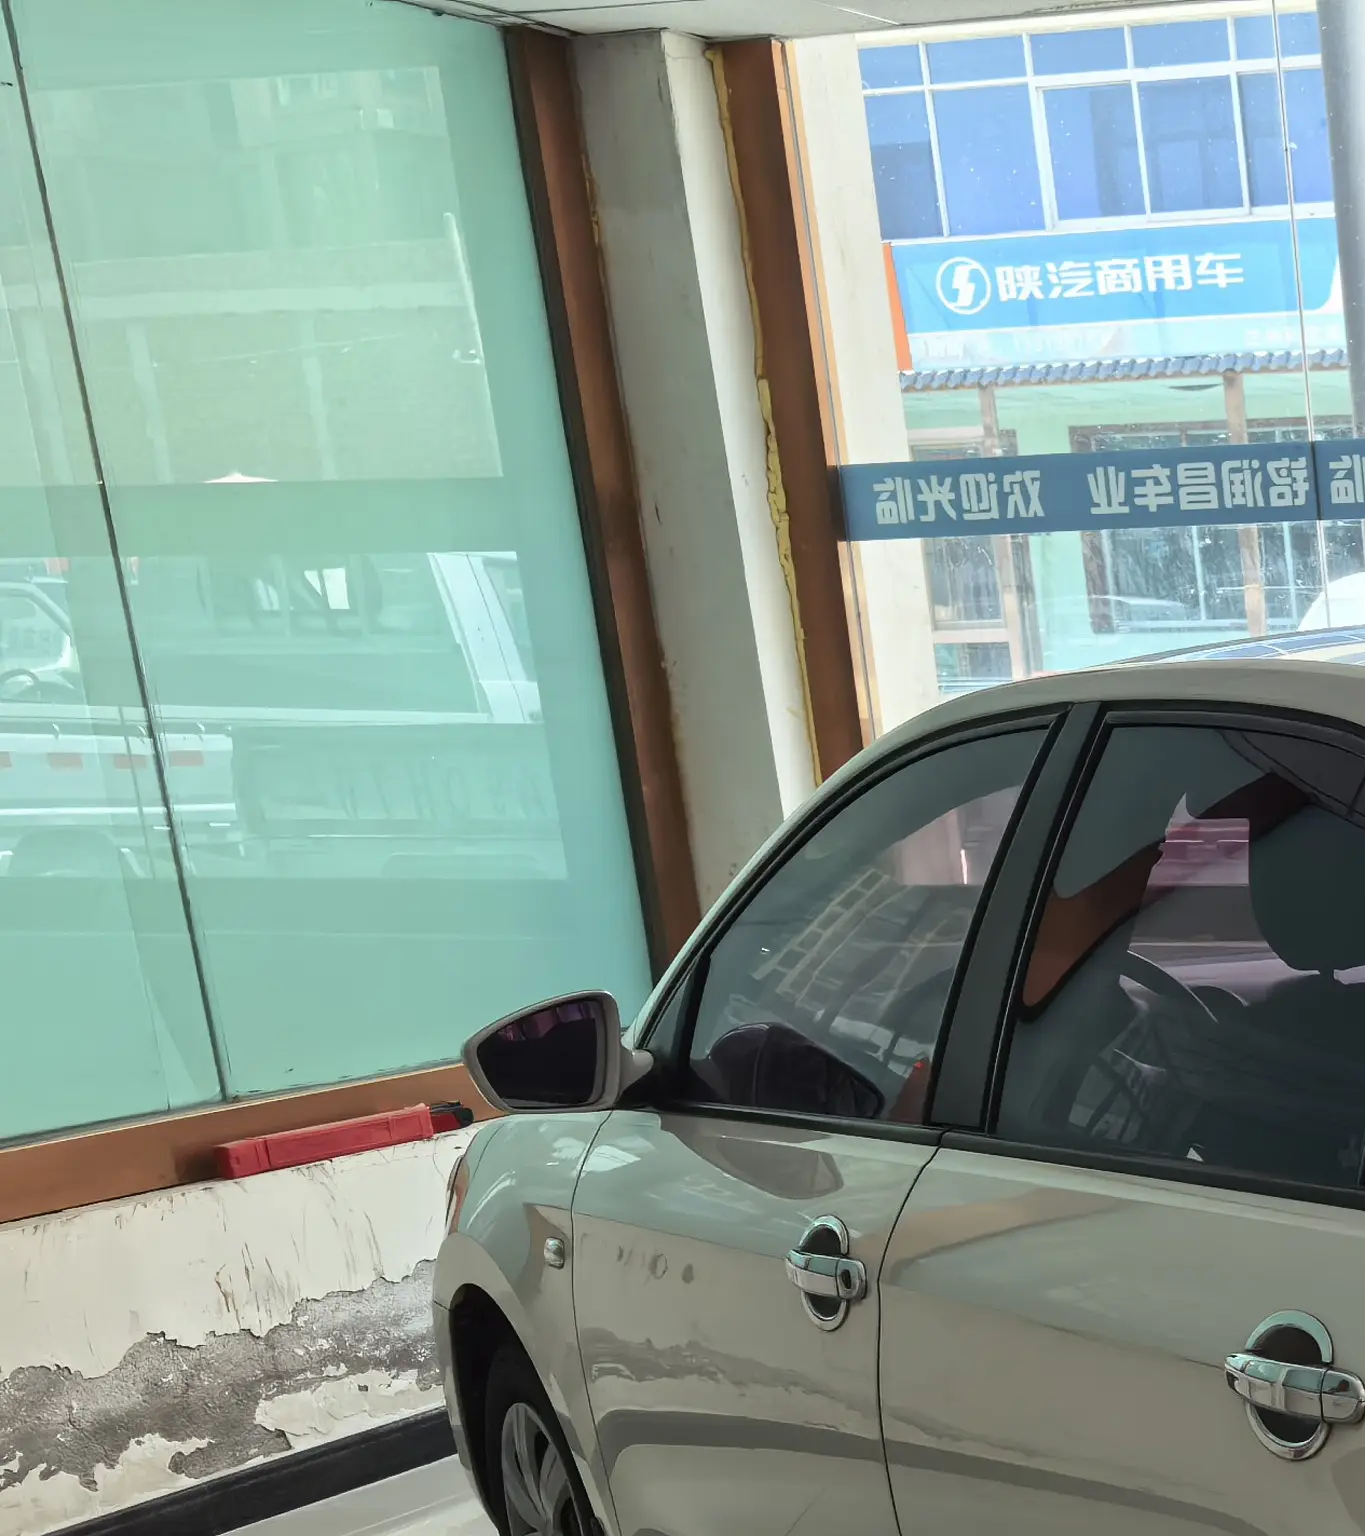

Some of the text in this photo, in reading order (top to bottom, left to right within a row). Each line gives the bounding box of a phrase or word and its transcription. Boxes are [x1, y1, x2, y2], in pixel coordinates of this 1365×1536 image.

[995, 252, 1245, 302] 陕汽商用车
